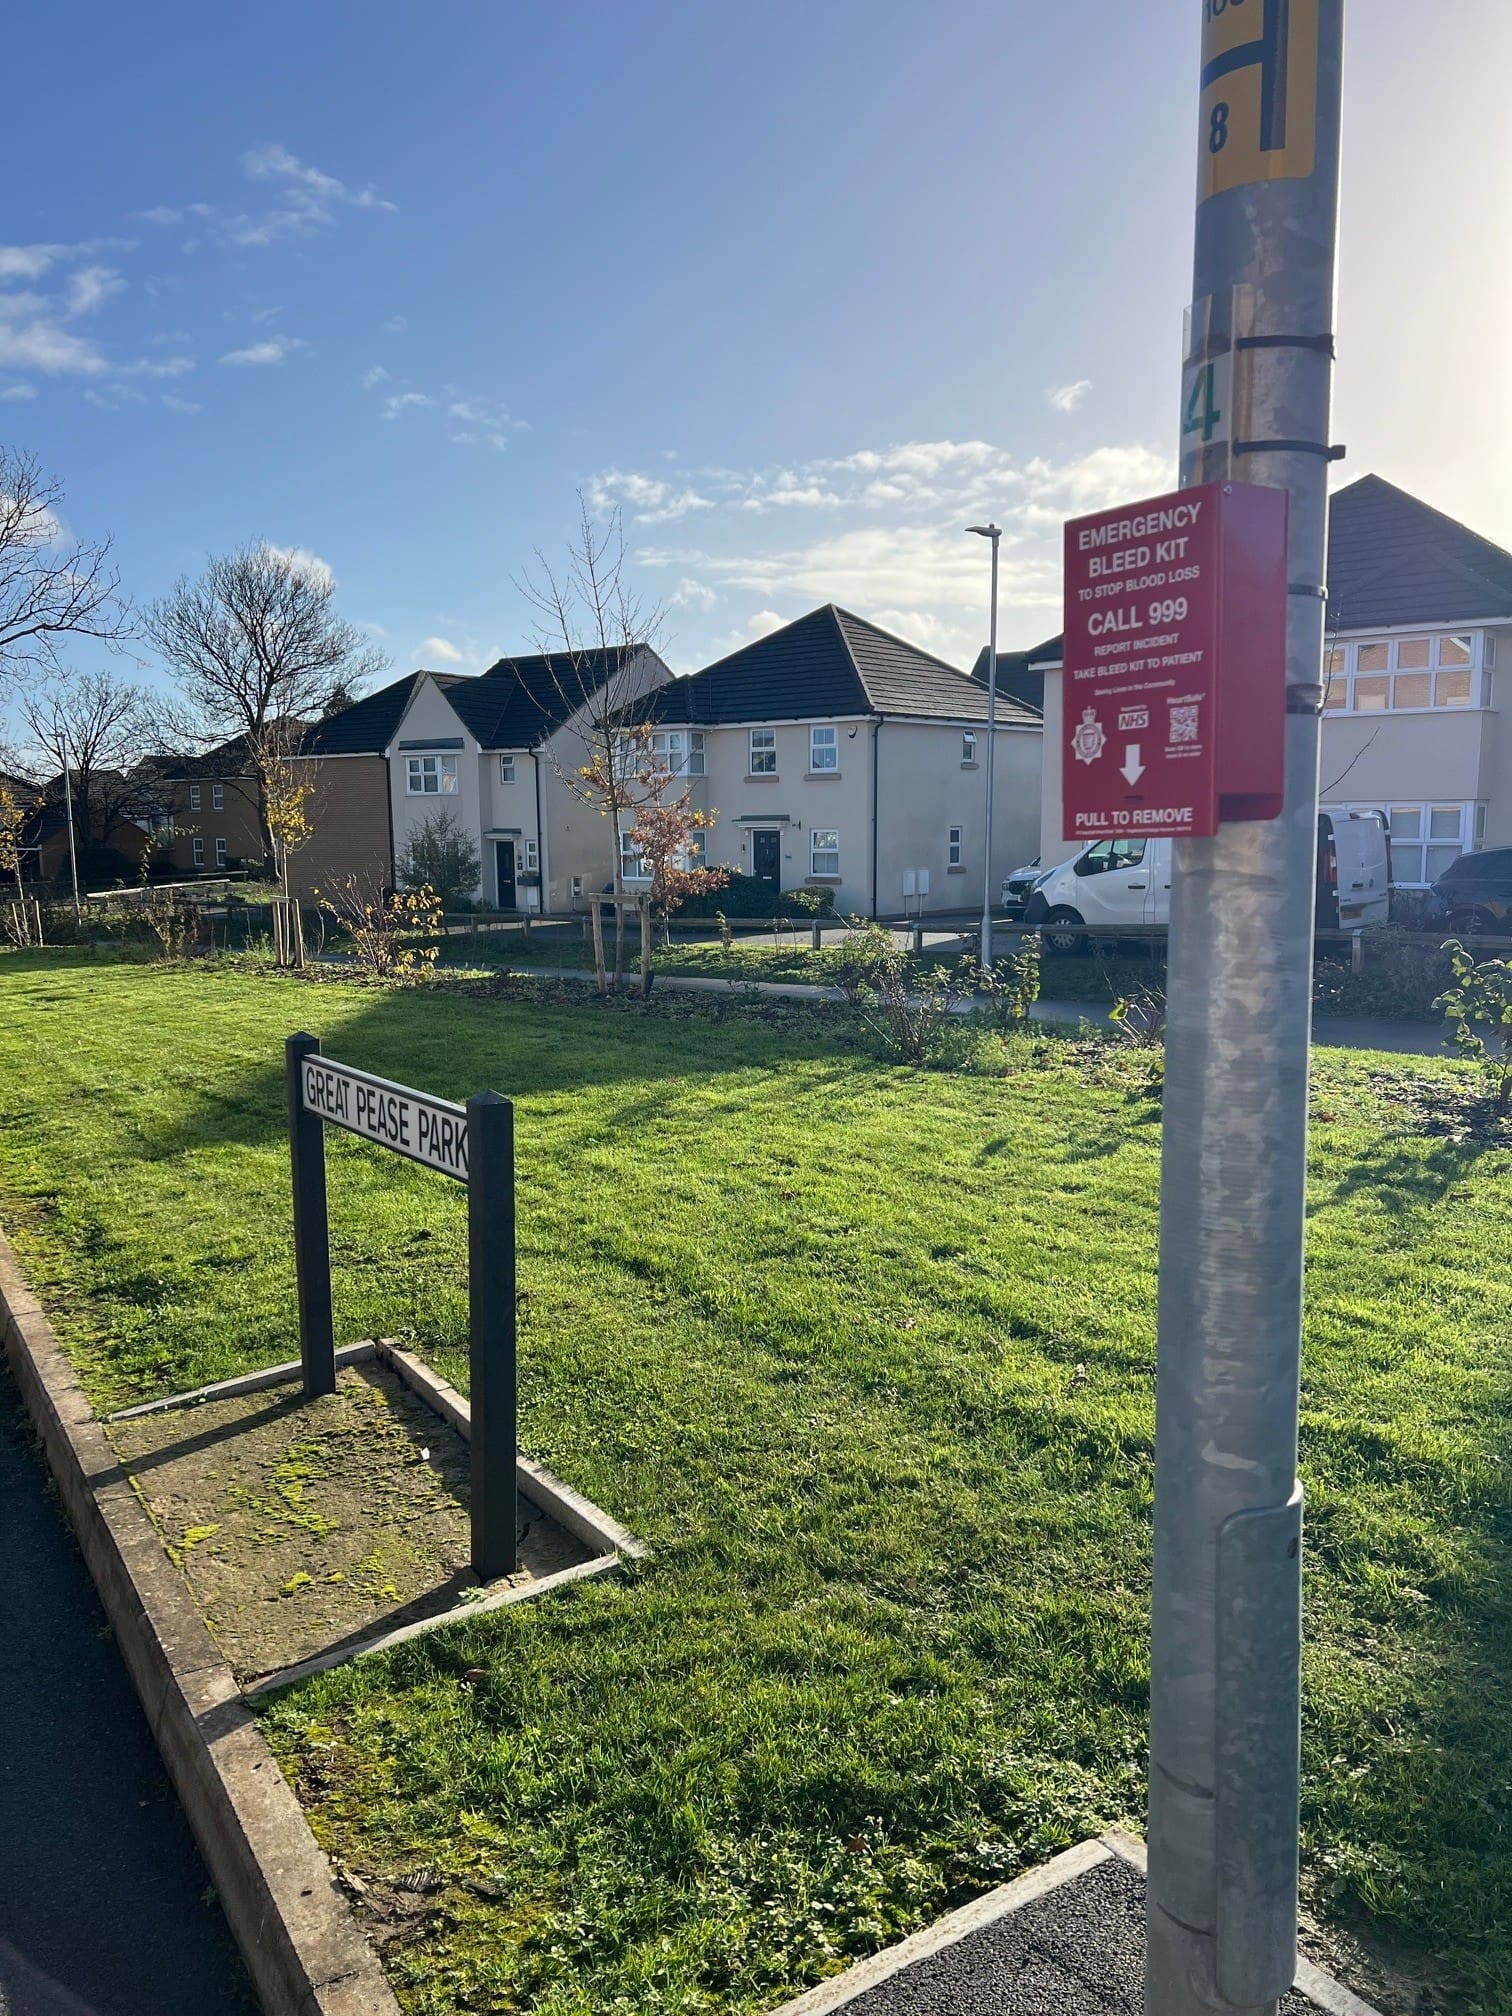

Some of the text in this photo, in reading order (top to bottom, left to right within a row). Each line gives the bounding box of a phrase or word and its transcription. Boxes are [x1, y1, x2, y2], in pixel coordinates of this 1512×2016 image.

[1209, 102, 1230, 153] 8
[1183, 363, 1221, 441] 4
[1079, 502, 1202, 550] EMERGENCY
[1089, 537, 1189, 578] BLEED KIT
[1078, 565, 1200, 601] TO STOP BLOOD LOSS
[1088, 597, 1188, 636] CALL 999
[1094, 633, 1179, 656] REPORT INCIDENT
[1073, 651, 1203, 680] TAKE BLEED KIT TO PATIENT
[1119, 712, 1148, 729] NHS
[1075, 807, 1193, 827] PULL TO REMOVE
[306, 1066, 469, 1172] GREAT PEASE PARK
